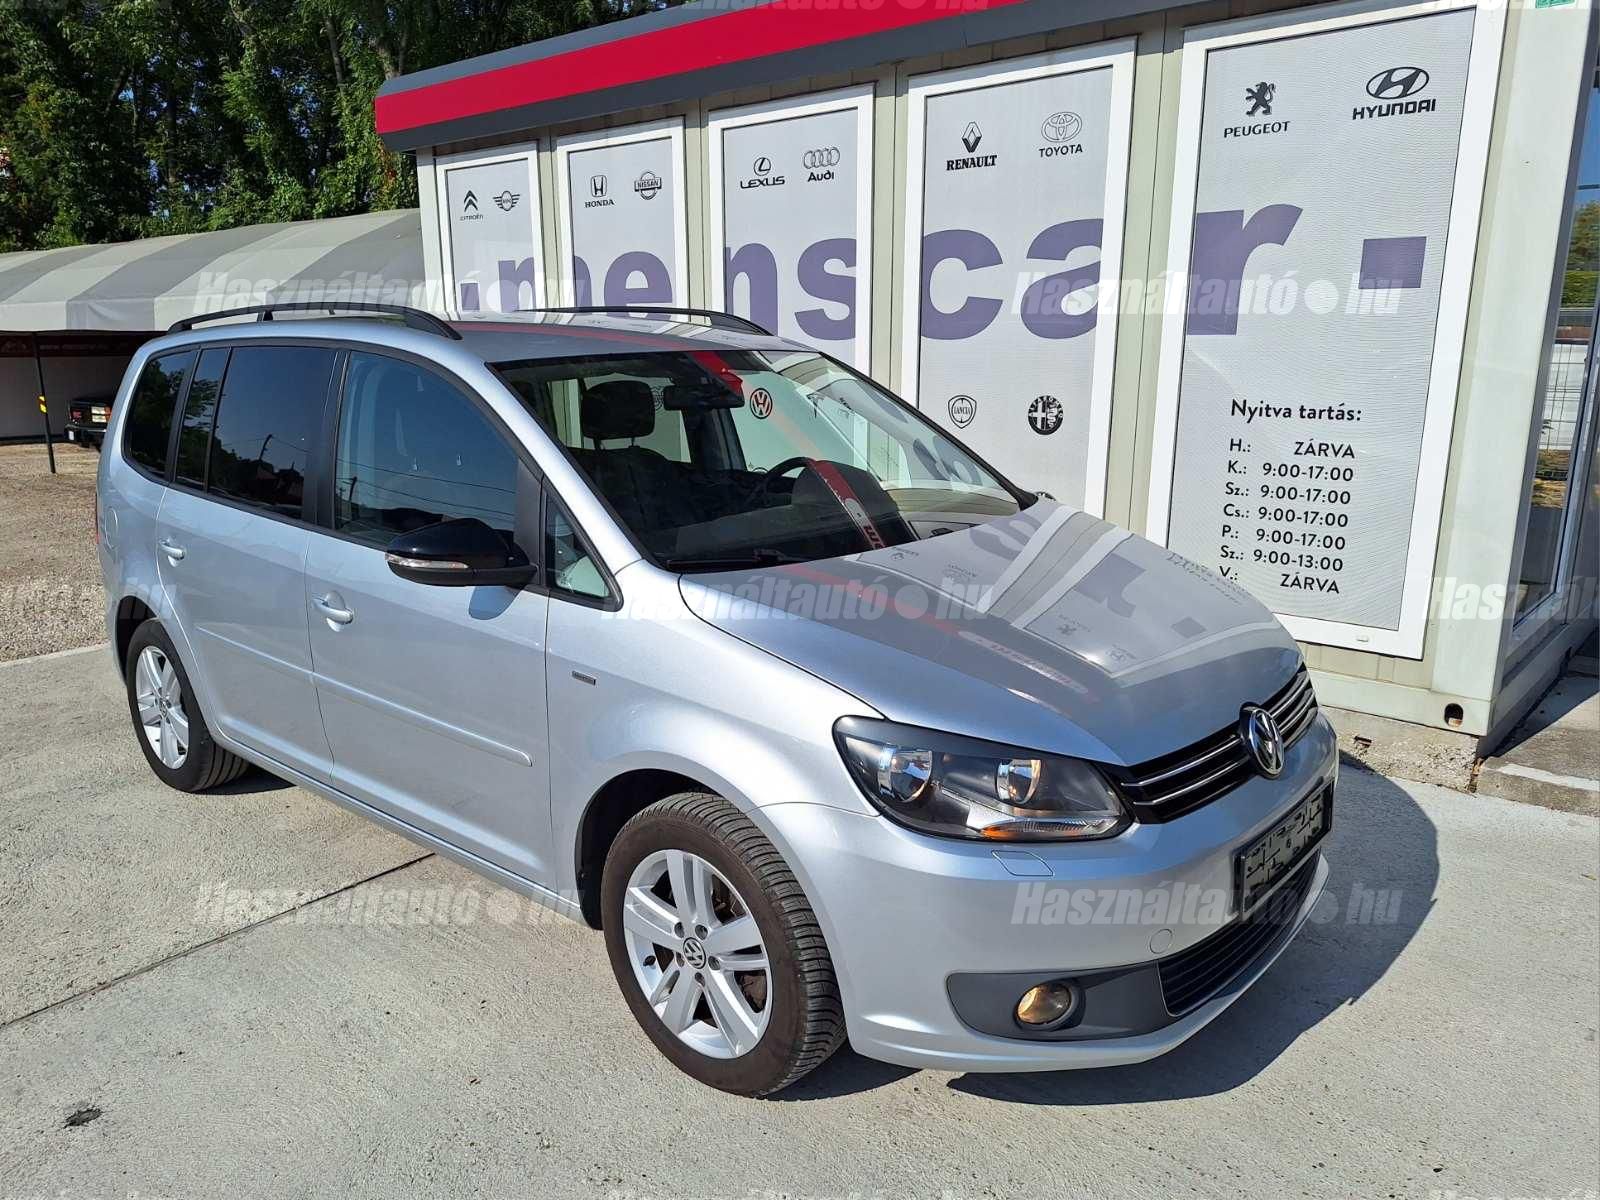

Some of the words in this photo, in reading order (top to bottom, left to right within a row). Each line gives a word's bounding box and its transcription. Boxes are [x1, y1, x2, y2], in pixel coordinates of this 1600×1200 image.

[1352, 99, 1437, 120] HYUNDAI
[1224, 121, 1291, 138] PEUGEOT
[1039, 144, 1083, 158] TOYOTA
[946, 155, 998, 171] RENAULT
[740, 176, 786, 189] LEXUS
[807, 171, 835, 182] Audi
[584, 199, 616, 208] HONDA
[1231, 399, 1292, 424] Nyitva
[1299, 403, 1362, 421] tartás:
[1294, 438, 1356, 459] ZÁRVA
[1262, 462, 1354, 481] 9:00-17:00
[1260, 484, 1351, 504] 9:00-17:00
[1258, 506, 1349, 528] 9:00-17:00
[1256, 528, 1346, 550] 9:00-17:00
[1253, 550, 1344, 571] 9:00-13:00
[1280, 571, 1340, 594] ZÁRVA
